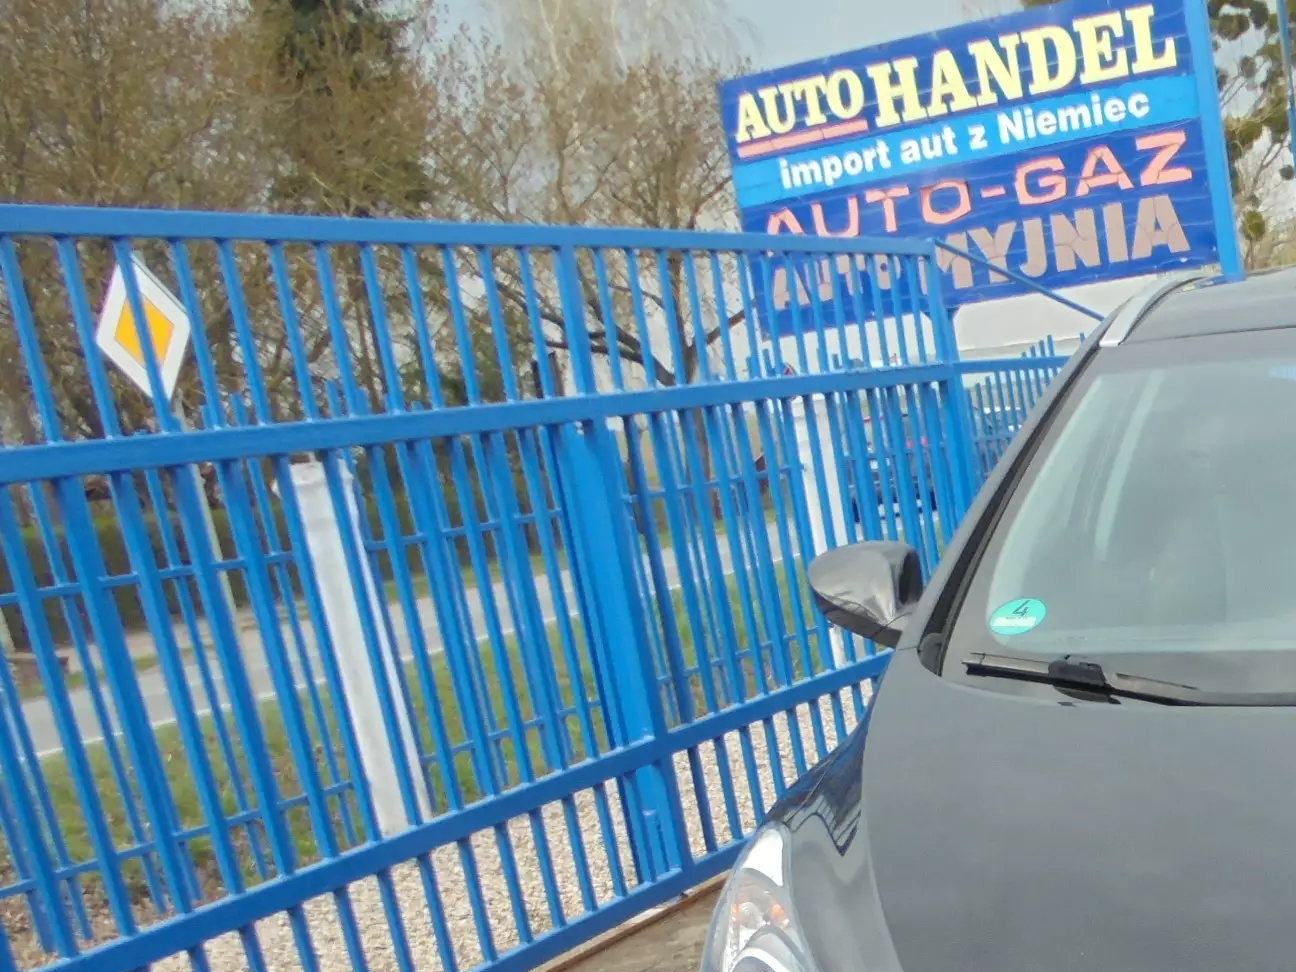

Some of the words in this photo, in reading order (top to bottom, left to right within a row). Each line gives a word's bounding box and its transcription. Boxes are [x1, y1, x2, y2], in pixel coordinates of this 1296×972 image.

[735, 69, 864, 143] AUTO
[867, 5, 1176, 127] HANDEL
[779, 138, 892, 190] import
[900, 125, 958, 164] aut
[968, 125, 988, 150] z
[997, 92, 1150, 144] Niemiec
[1012, 599, 1032, 617] 4
